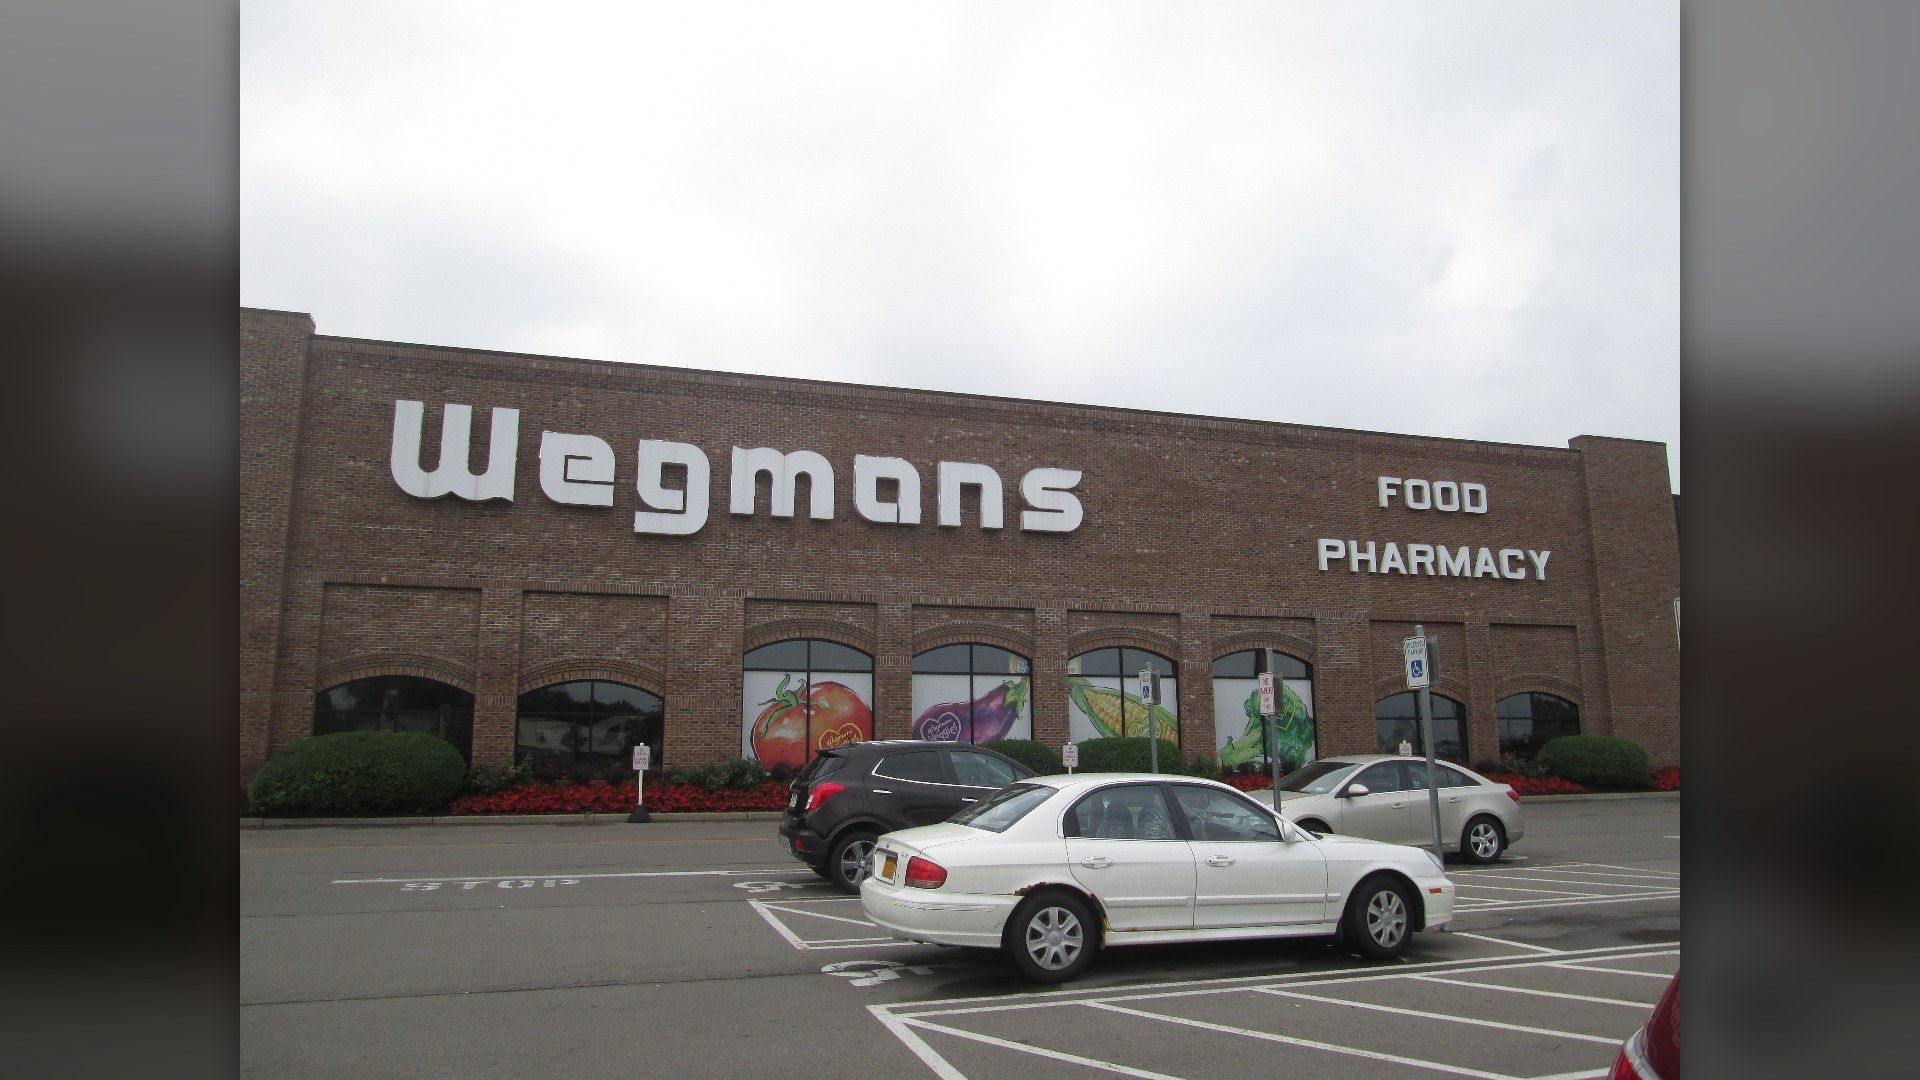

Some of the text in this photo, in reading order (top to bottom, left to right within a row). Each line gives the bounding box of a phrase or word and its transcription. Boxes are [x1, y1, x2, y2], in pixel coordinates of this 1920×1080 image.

[391, 399, 1083, 536] Wegmans
[1378, 476, 1488, 514] FOOD
[1317, 538, 1551, 581] PHARMACY
[400, 879, 580, 891] STOP
